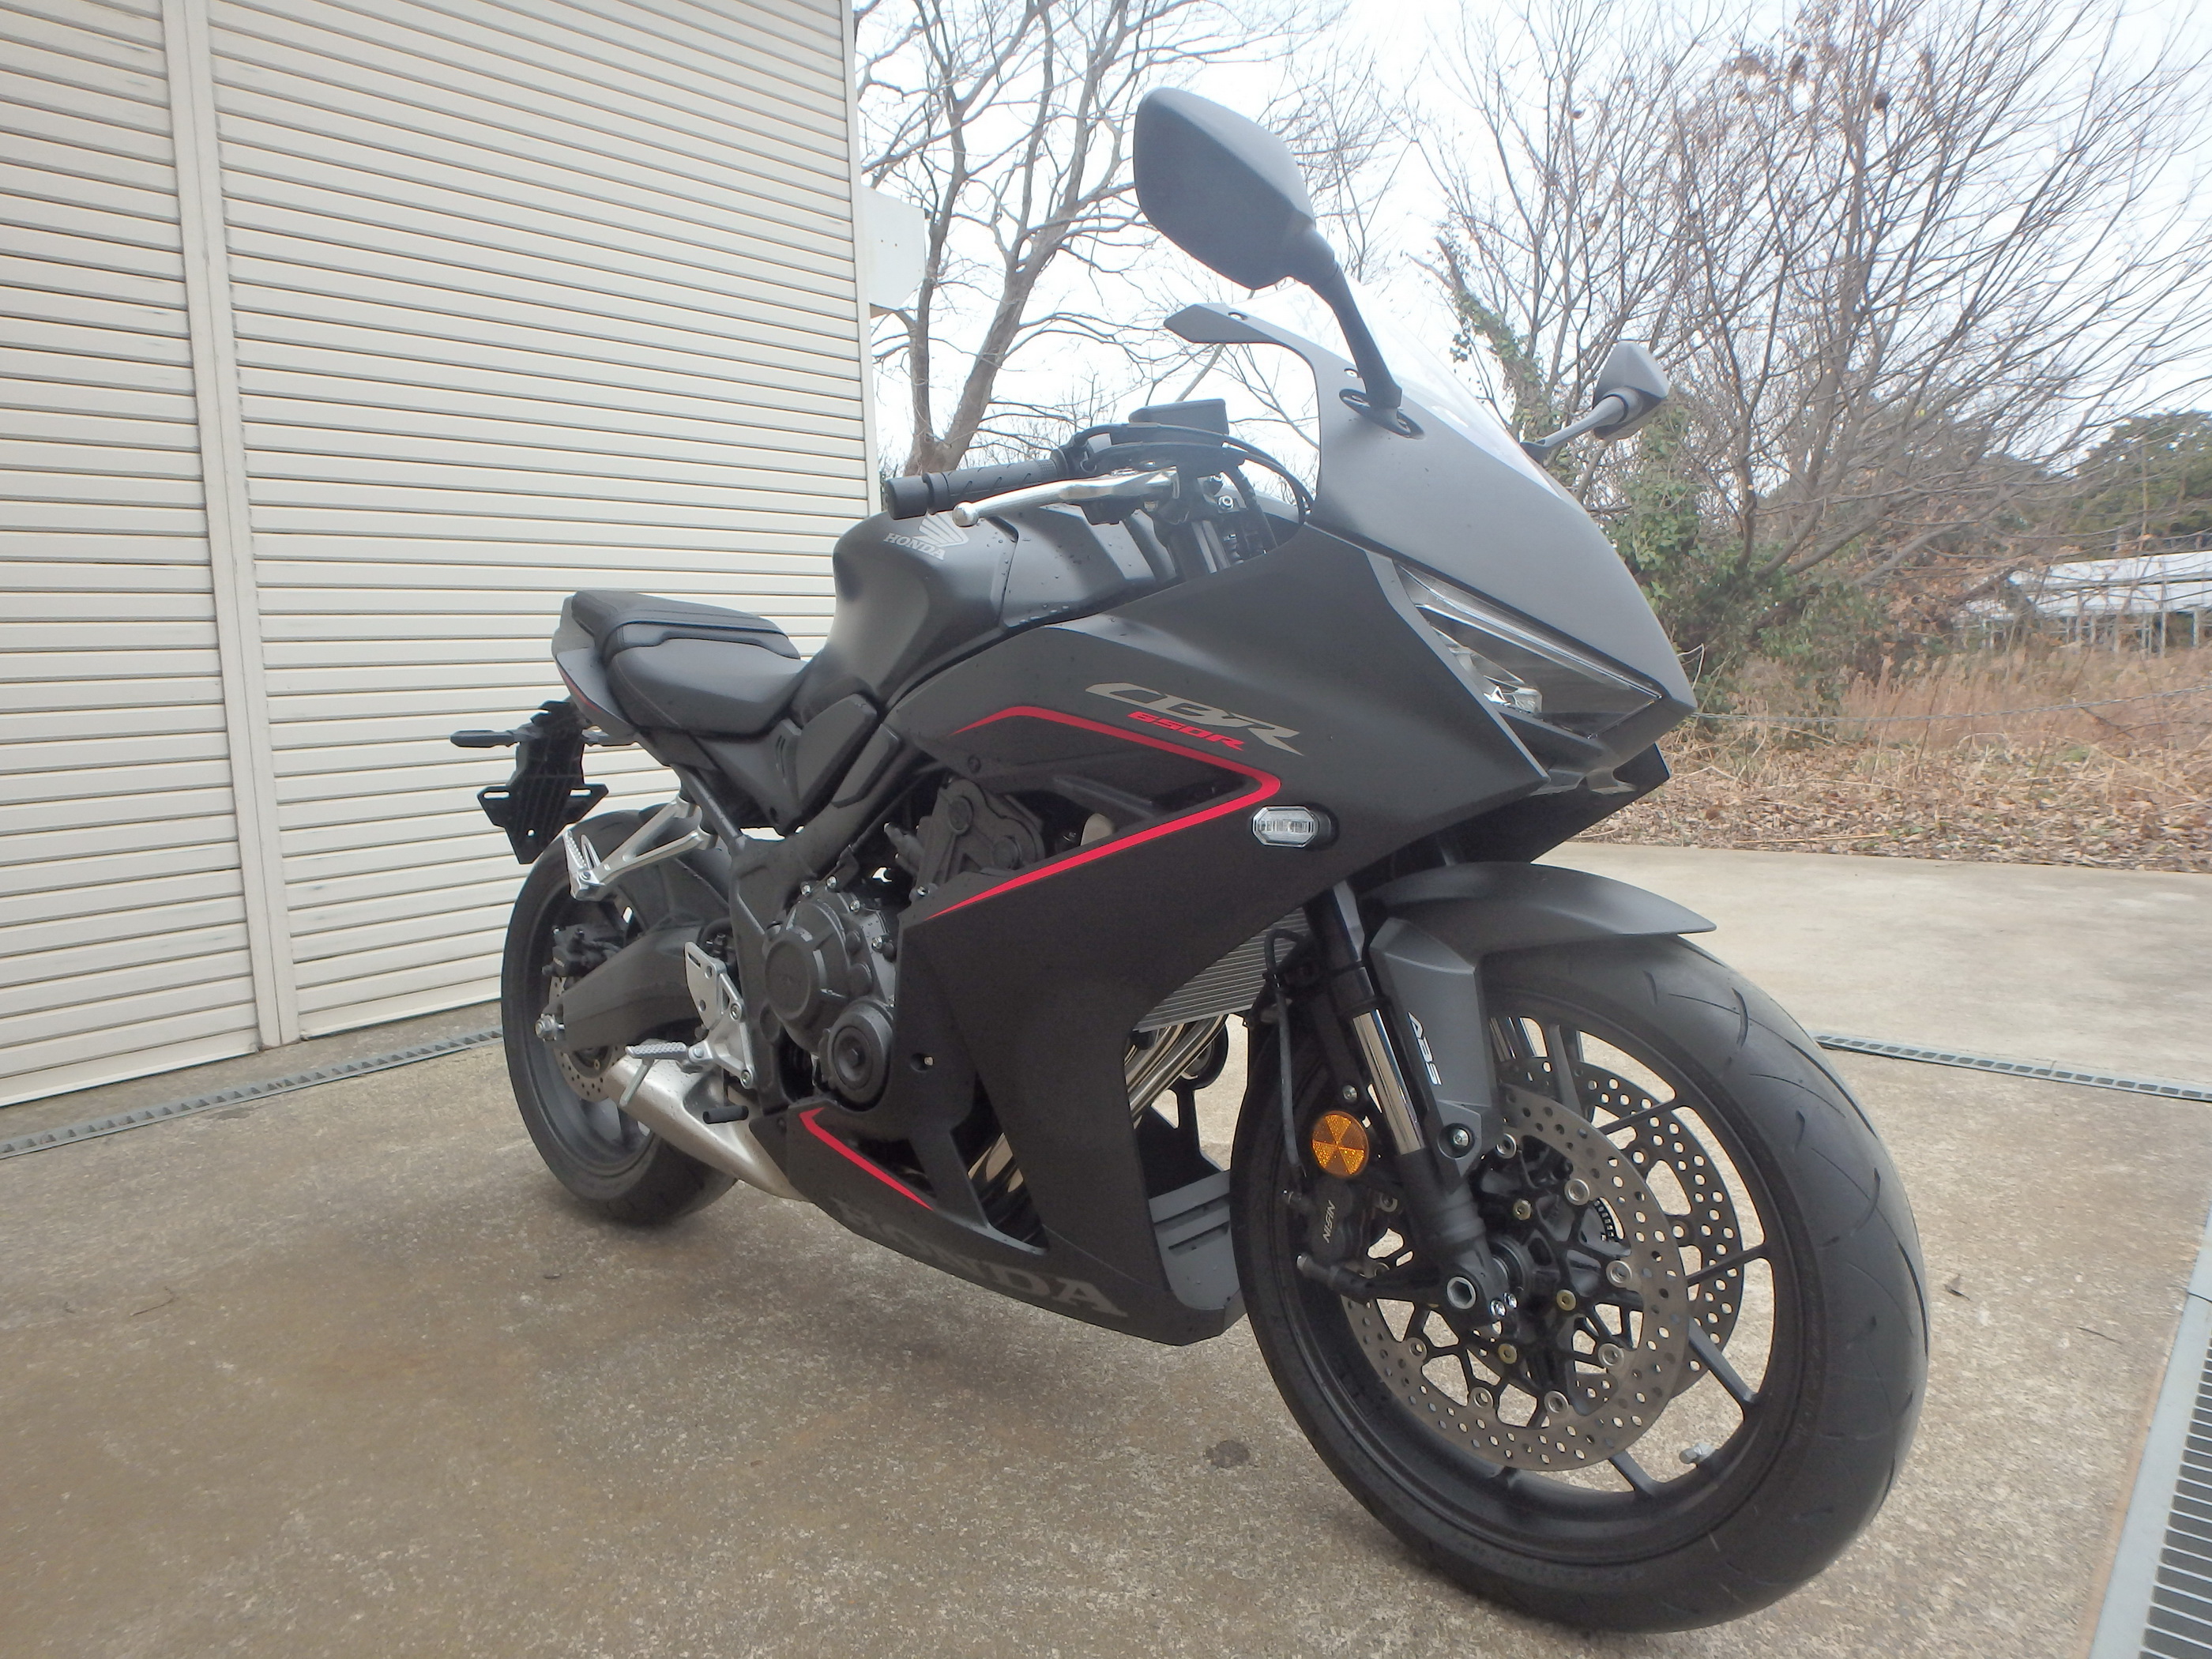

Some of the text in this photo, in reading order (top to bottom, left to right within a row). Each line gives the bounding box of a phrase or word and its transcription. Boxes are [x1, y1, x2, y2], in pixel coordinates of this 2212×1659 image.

[883, 532, 946, 561] HONDA
[1085, 682, 1305, 756] CBR
[1127, 711, 1245, 751] 650R
[1407, 1010, 1443, 1085] ABS
